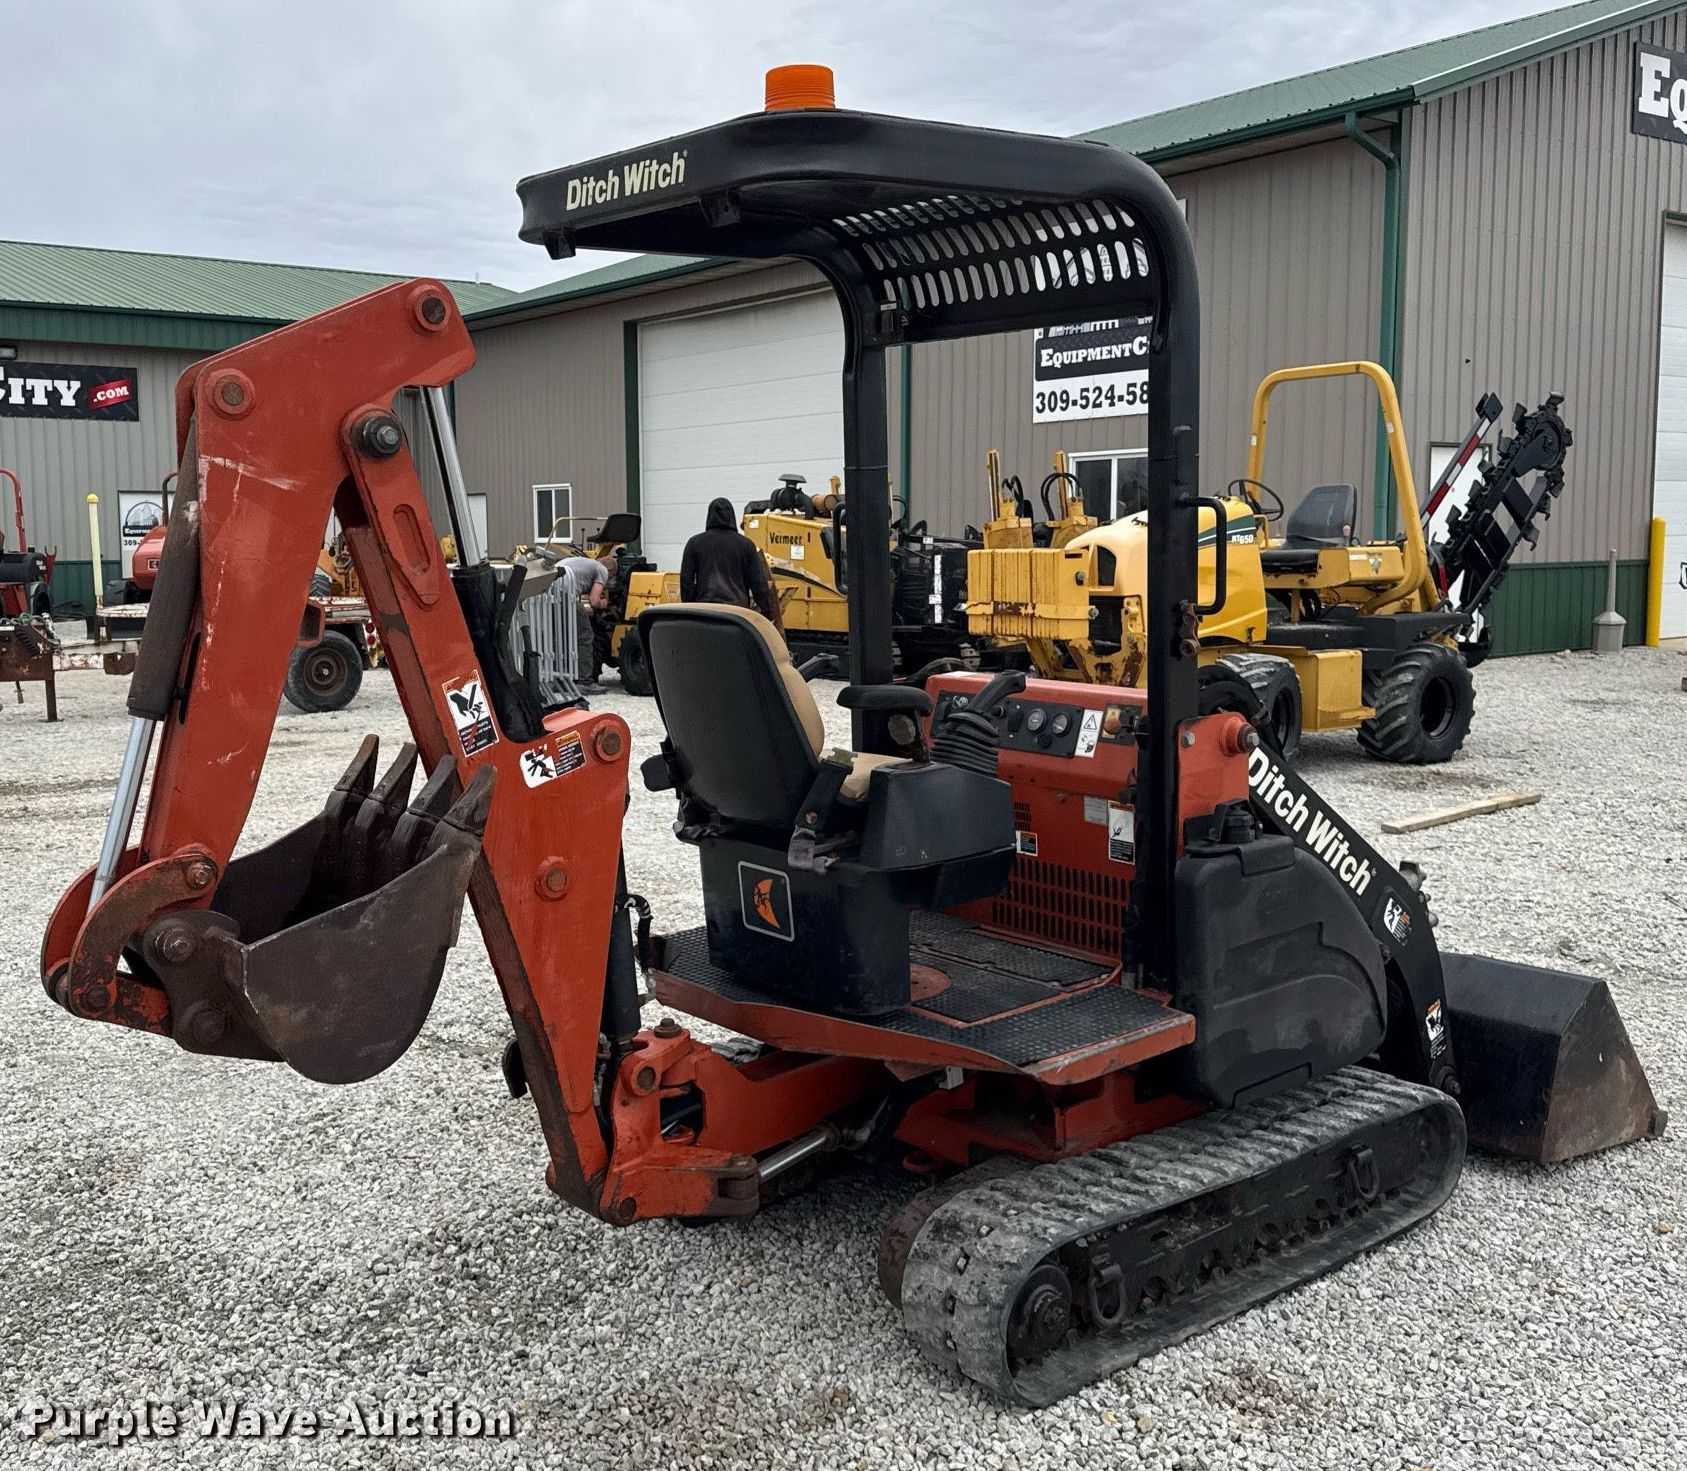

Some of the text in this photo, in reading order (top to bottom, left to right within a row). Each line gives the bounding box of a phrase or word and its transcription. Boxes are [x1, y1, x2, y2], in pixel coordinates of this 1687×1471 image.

[566, 151, 686, 211] Ditch Witch
[1040, 335, 1150, 368] EQUIPMENTC
[0, 366, 129, 406] ITY .COM
[769, 531, 803, 545] Vermeer
[1249, 747, 1371, 896] Ditch Witch
